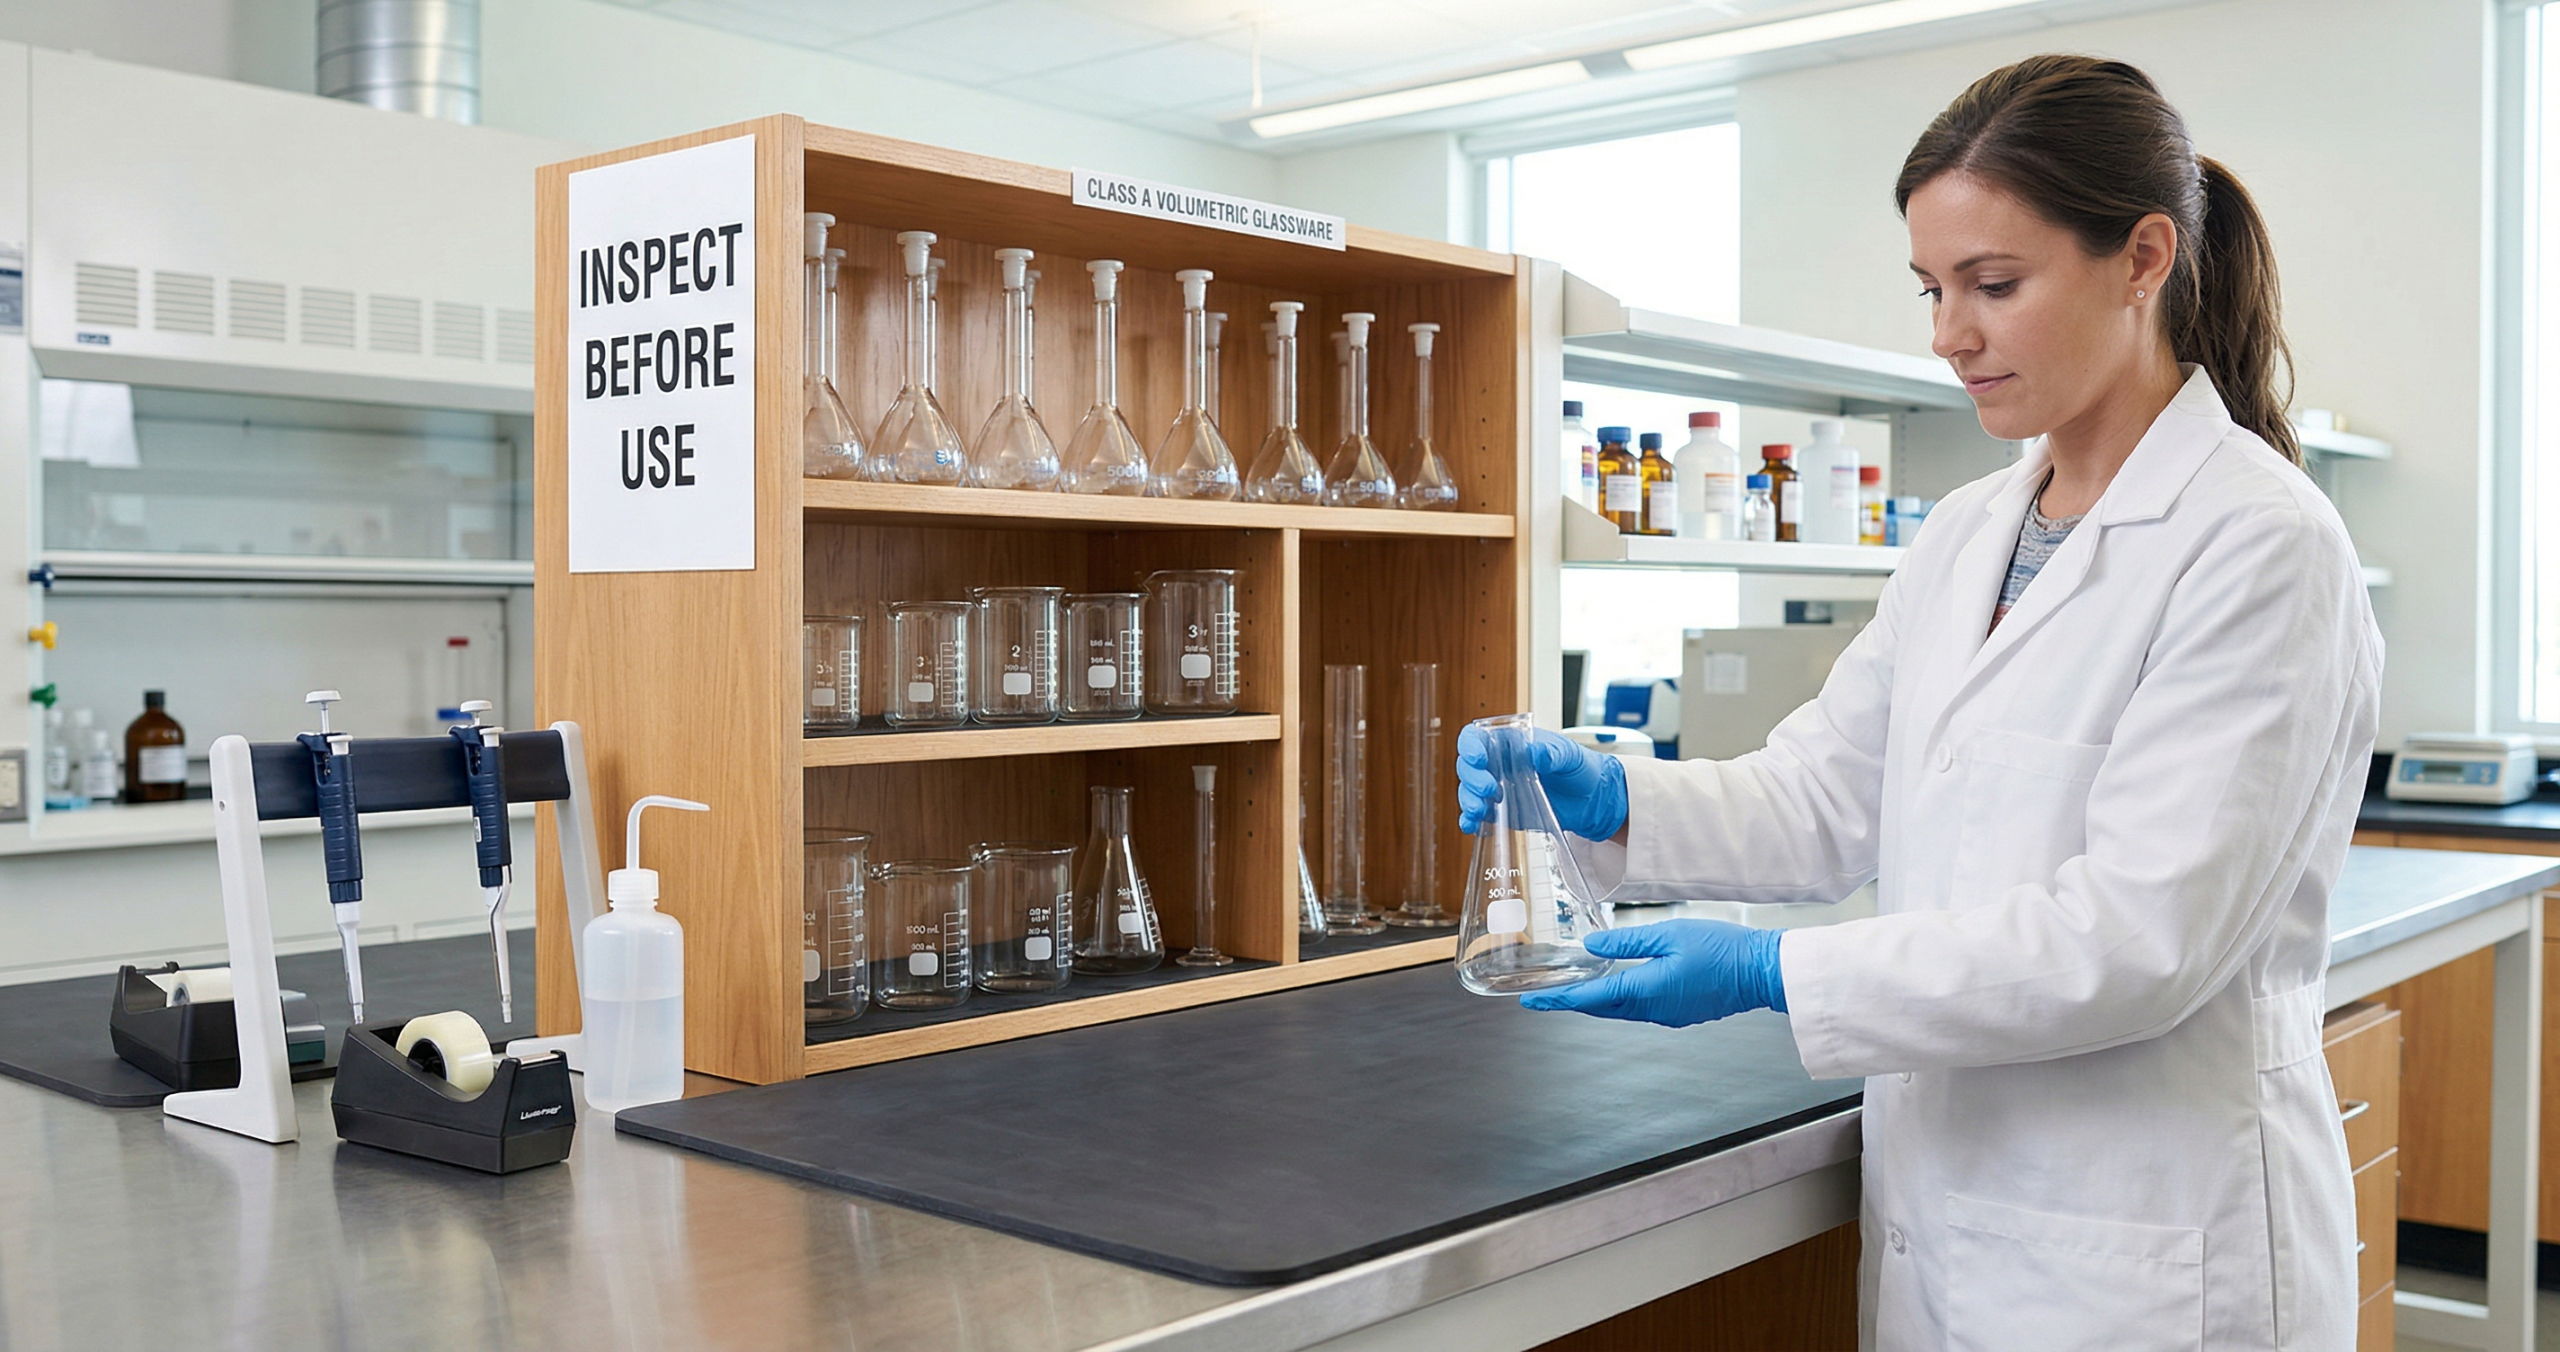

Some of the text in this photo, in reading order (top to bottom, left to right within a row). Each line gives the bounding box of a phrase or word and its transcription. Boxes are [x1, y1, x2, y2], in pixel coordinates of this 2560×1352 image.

[1087, 177, 1333, 241] CLASS A VOLUMETRIC GLASSWARE
[580, 222, 743, 308] INSPECT
[586, 322, 735, 400] BEFORE
[621, 423, 695, 490] USE
[1011, 644, 1021, 658] 2
[1484, 866, 1507, 881] 500
[1488, 886, 1506, 899] 500
